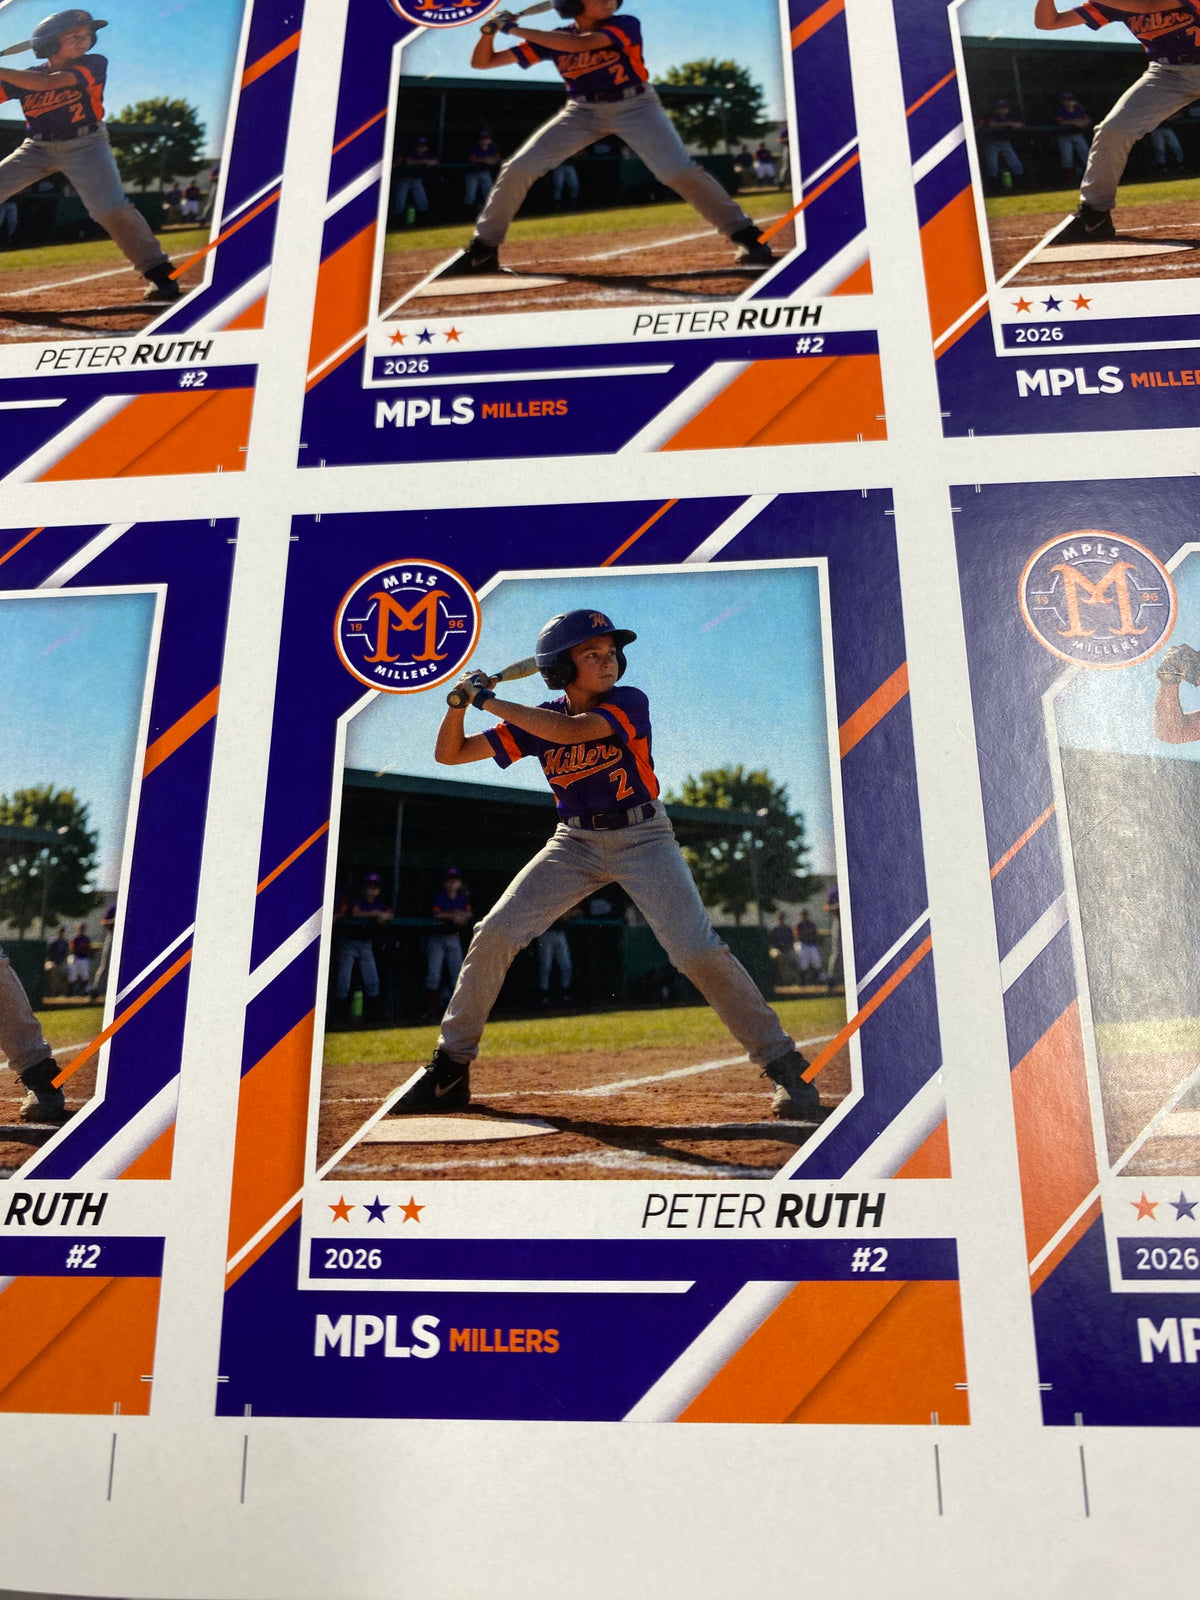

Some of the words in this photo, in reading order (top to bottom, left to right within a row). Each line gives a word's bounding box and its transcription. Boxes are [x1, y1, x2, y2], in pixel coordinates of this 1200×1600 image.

[422, 7, 473, 20] MILLERS
[609, 64, 629, 85] 2
[69, 103, 86, 123] 2
[633, 310, 729, 336] PETER
[736, 305, 822, 331] RUTH
[795, 337, 825, 354] #2
[1015, 327, 1064, 343] 2026
[35, 345, 127, 371] PETER
[131, 340, 214, 365] RUTH
[383, 360, 430, 375] 2026
[179, 371, 208, 388] #2
[1015, 365, 1124, 398] MPLS
[375, 397, 475, 429] MPLS
[481, 400, 569, 419] MILLERS
[1061, 543, 1120, 561] MPLS
[383, 572, 438, 589] MPLS
[350, 623, 363, 632] 19
[448, 620, 464, 629] 96
[1072, 637, 1139, 655] MILLERS
[374, 662, 437, 680] MILLERS
[543, 743, 621, 775] Millers
[609, 768, 634, 801] 2
[4, 1193, 109, 1226] RUTH
[642, 1193, 765, 1228] PETER
[775, 1192, 886, 1228] RUTH
[66, 1244, 101, 1268] #2
[324, 1248, 382, 1269] 2026
[851, 1247, 889, 1272] #2
[1135, 1248, 1199, 1270] 2026
[314, 1314, 441, 1359] MPLS
[449, 1328, 560, 1354] MILLERS
